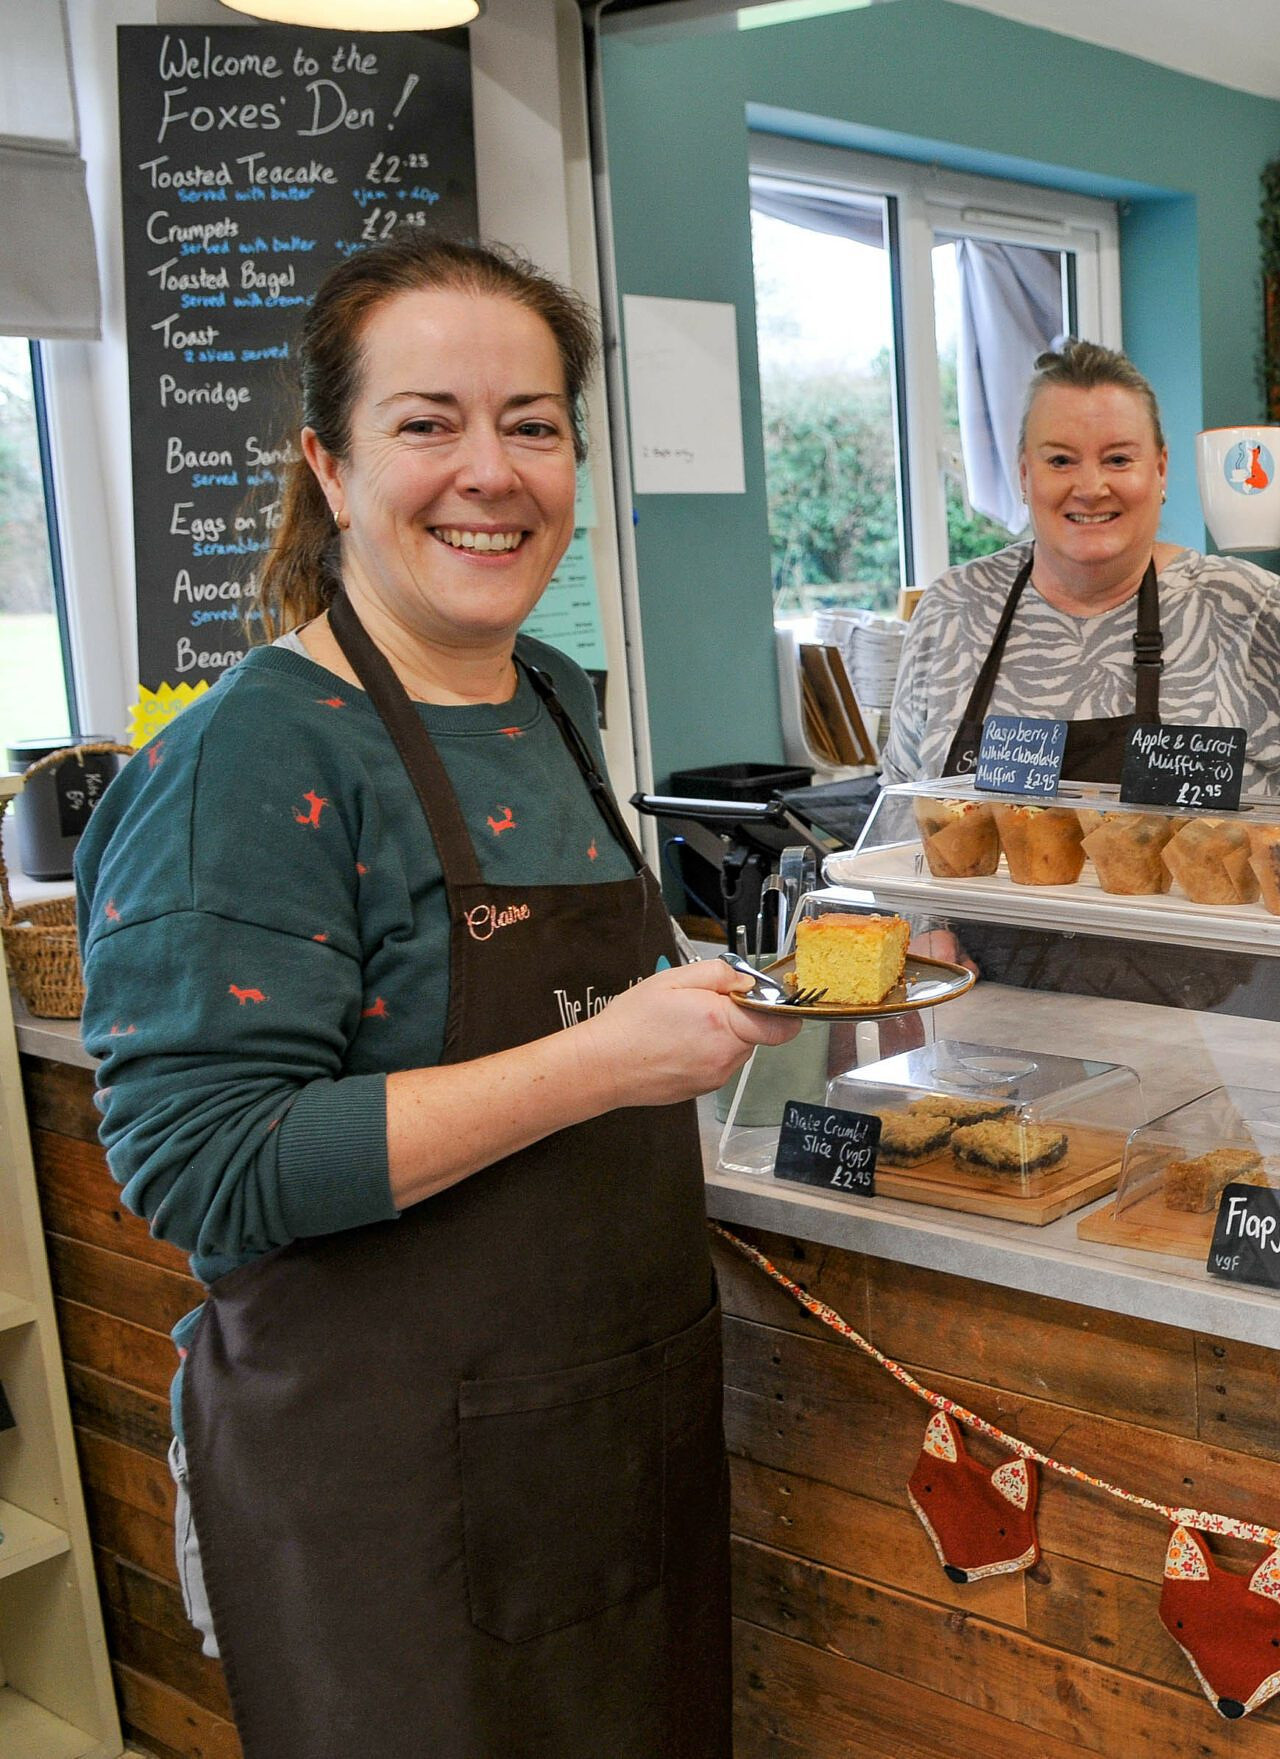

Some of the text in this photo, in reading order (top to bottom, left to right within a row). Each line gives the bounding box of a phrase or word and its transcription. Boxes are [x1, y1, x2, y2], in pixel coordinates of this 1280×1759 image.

[159, 35, 379, 80] Welcome to the
[157, 86, 287, 143] Foxes'
[297, 79, 375, 136] Den
[139, 155, 233, 189] Toasted
[236, 152, 338, 187] Teacake
[234, 187, 265, 201] with
[270, 186, 315, 200] butter
[147, 211, 239, 248] Crumpets
[239, 238, 268, 253] with
[273, 237, 317, 252] butter
[147, 257, 296, 298] Toasted Bagel
[233, 292, 263, 307] with
[151, 313, 220, 349] Toast
[159, 374, 252, 411] Porridge
[165, 436, 233, 474] Bacon
[169, 501, 227, 542] Eggs
[234, 517, 257, 531] on
[985, 720, 1049, 751] Raspberry
[1131, 728, 1237, 757] Apple & Carrot
[976, 764, 1056, 791] Muffins £2.95
[1148, 751, 1205, 776] Muffin
[1176, 782, 1222, 806] £2.95
[464, 903, 531, 941] Claire
[802, 1135, 832, 1158] Slice
[830, 1165, 872, 1189] £2.95
